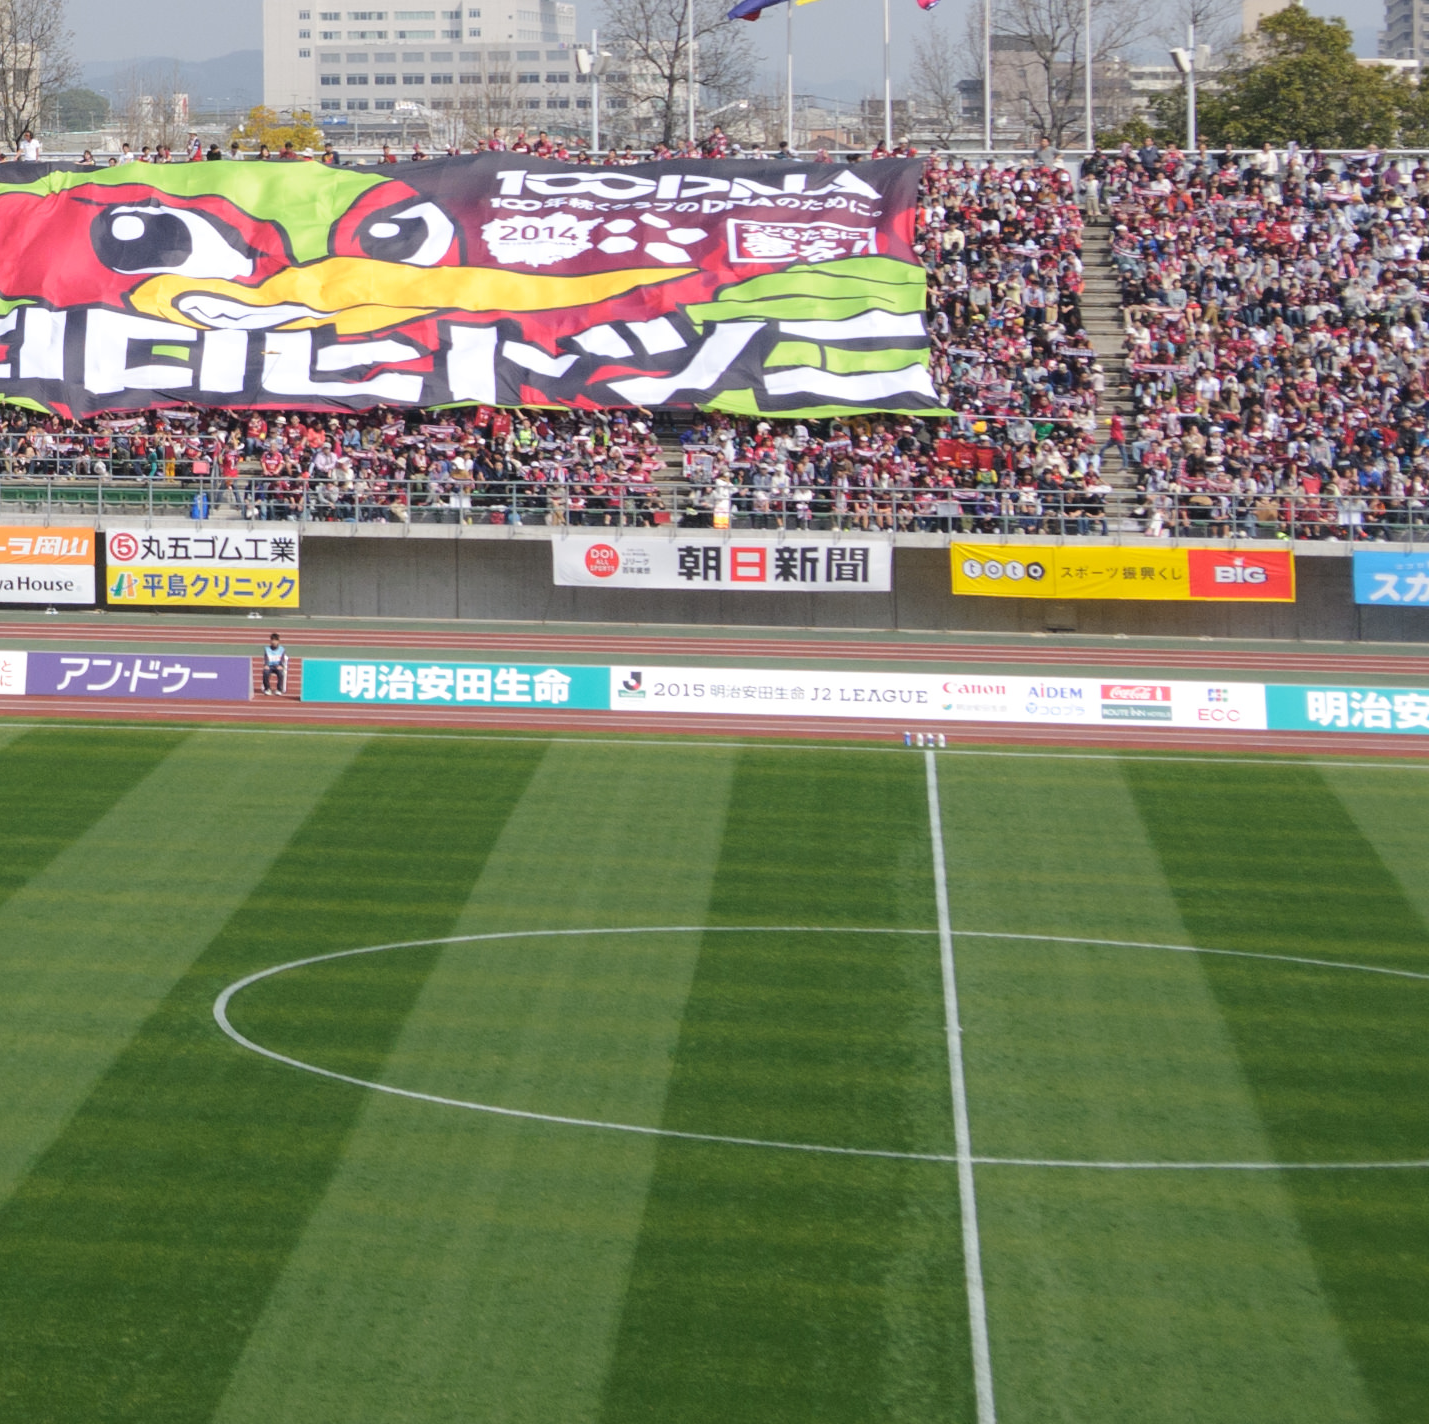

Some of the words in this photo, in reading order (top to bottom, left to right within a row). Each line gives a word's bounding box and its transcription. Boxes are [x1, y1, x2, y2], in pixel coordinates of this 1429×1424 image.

[499, 224, 579, 241] 2014
[140, 536, 296, 563] 丸五ゴム工業
[678, 546, 869, 584] 朝日新聞
[964, 559, 1045, 581] toto
[1061, 565, 1182, 581] スポーツ振興くじ
[16, 575, 75, 592] House
[142, 573, 296, 600] 平島クリニック
[338, 665, 572, 705] 明治安田生命
[653, 683, 706, 698] 2015
[710, 684, 806, 701] 明治安田生命
[810, 686, 832, 702] J2
[838, 688, 929, 704] LEAGUE
[942, 681, 1006, 695] Canon
[1197, 709, 1241, 722] ECC
